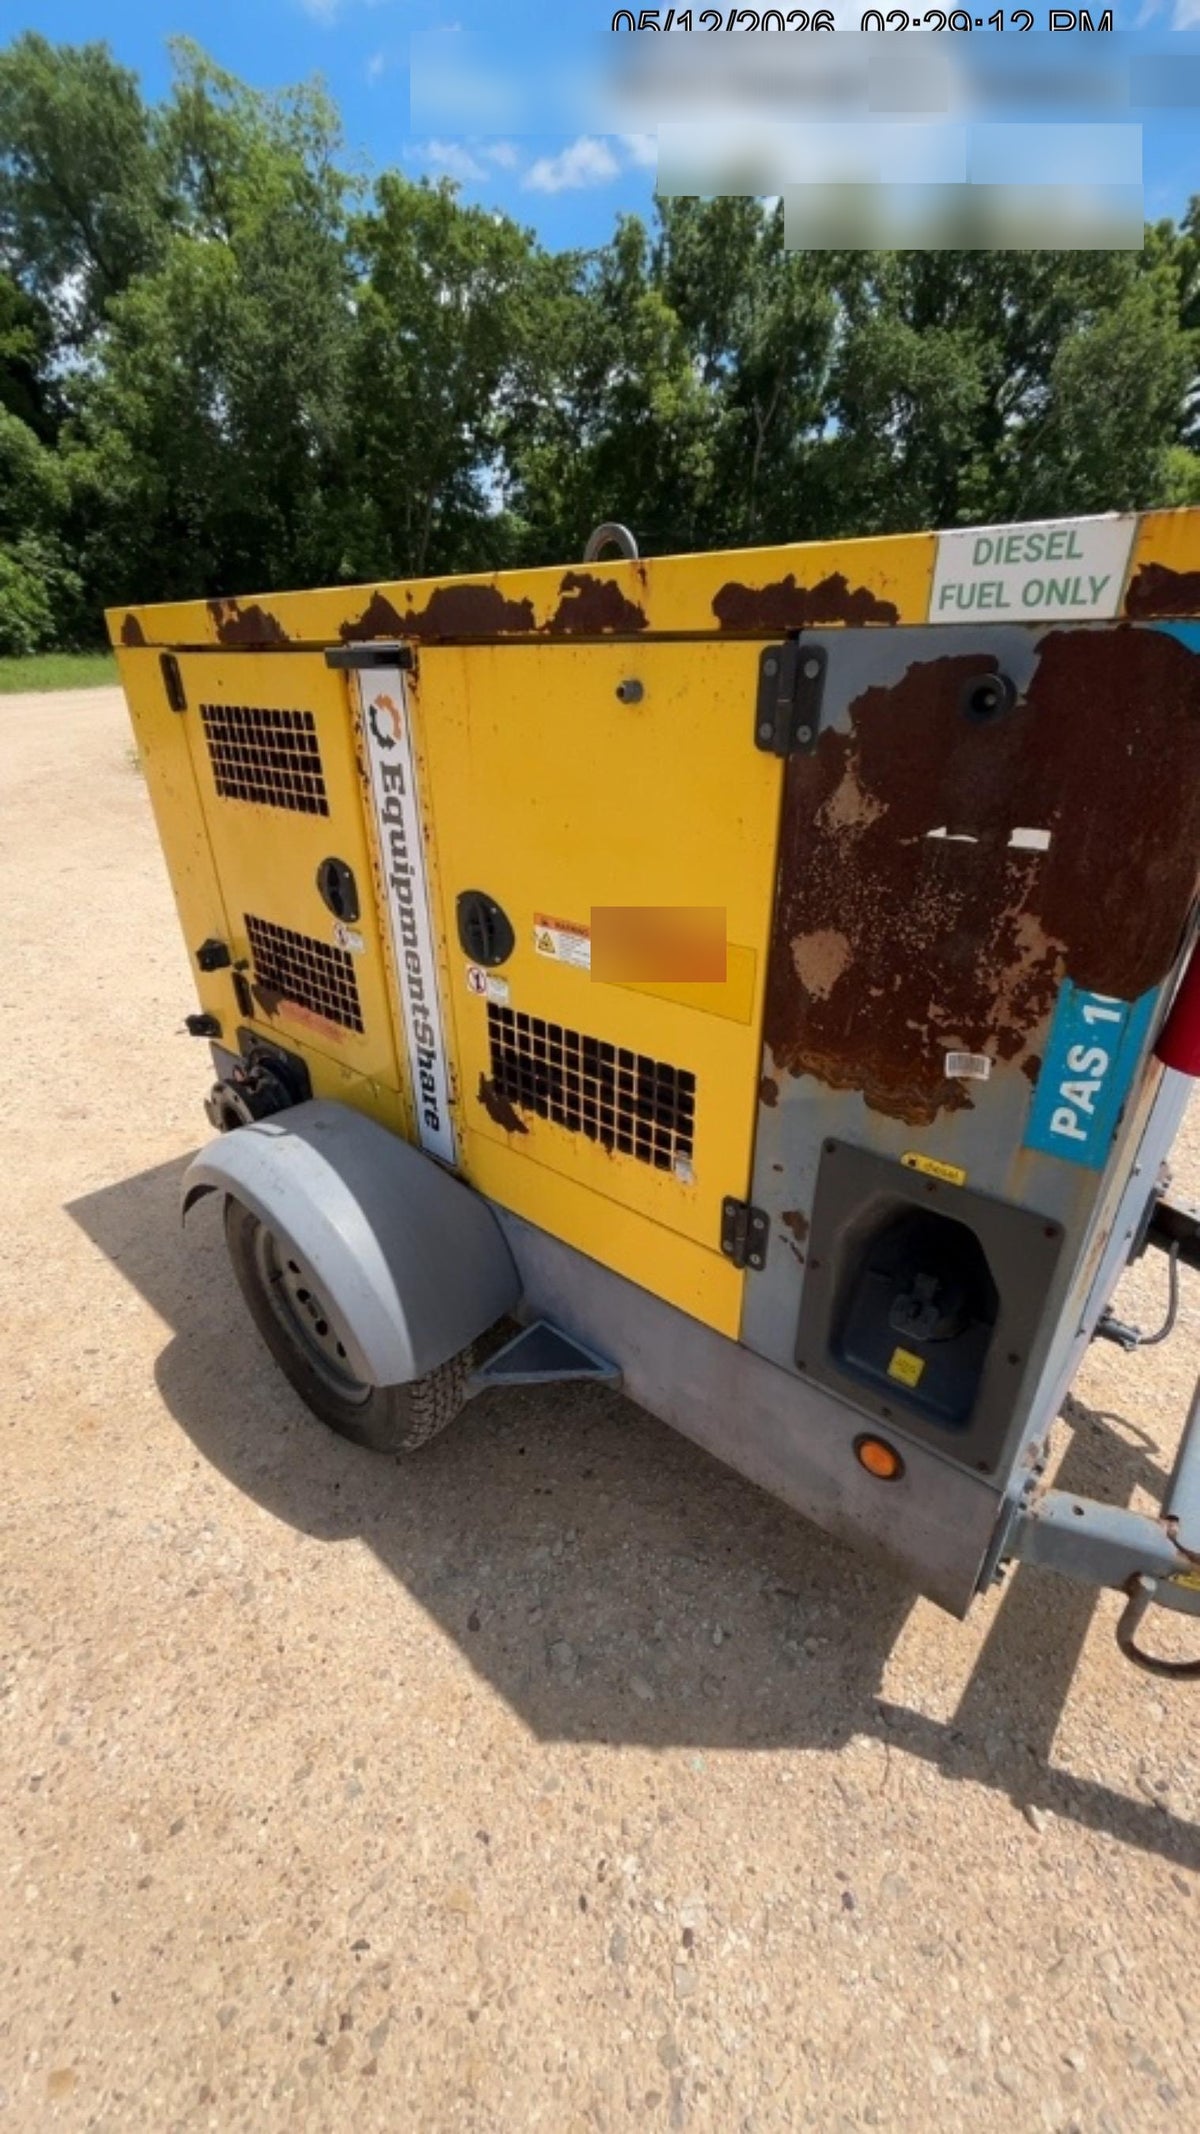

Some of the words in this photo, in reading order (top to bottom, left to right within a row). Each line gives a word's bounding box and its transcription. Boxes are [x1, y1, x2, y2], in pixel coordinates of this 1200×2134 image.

[938, 580, 1011, 610] FUEL
[1021, 575, 1110, 608] ONLY
[973, 530, 1083, 566] DIESEL
[379, 761, 440, 1132] EquipmentShare
[1050, 1045, 1109, 1141] PAS
[1082, 993, 1122, 1025] 1
